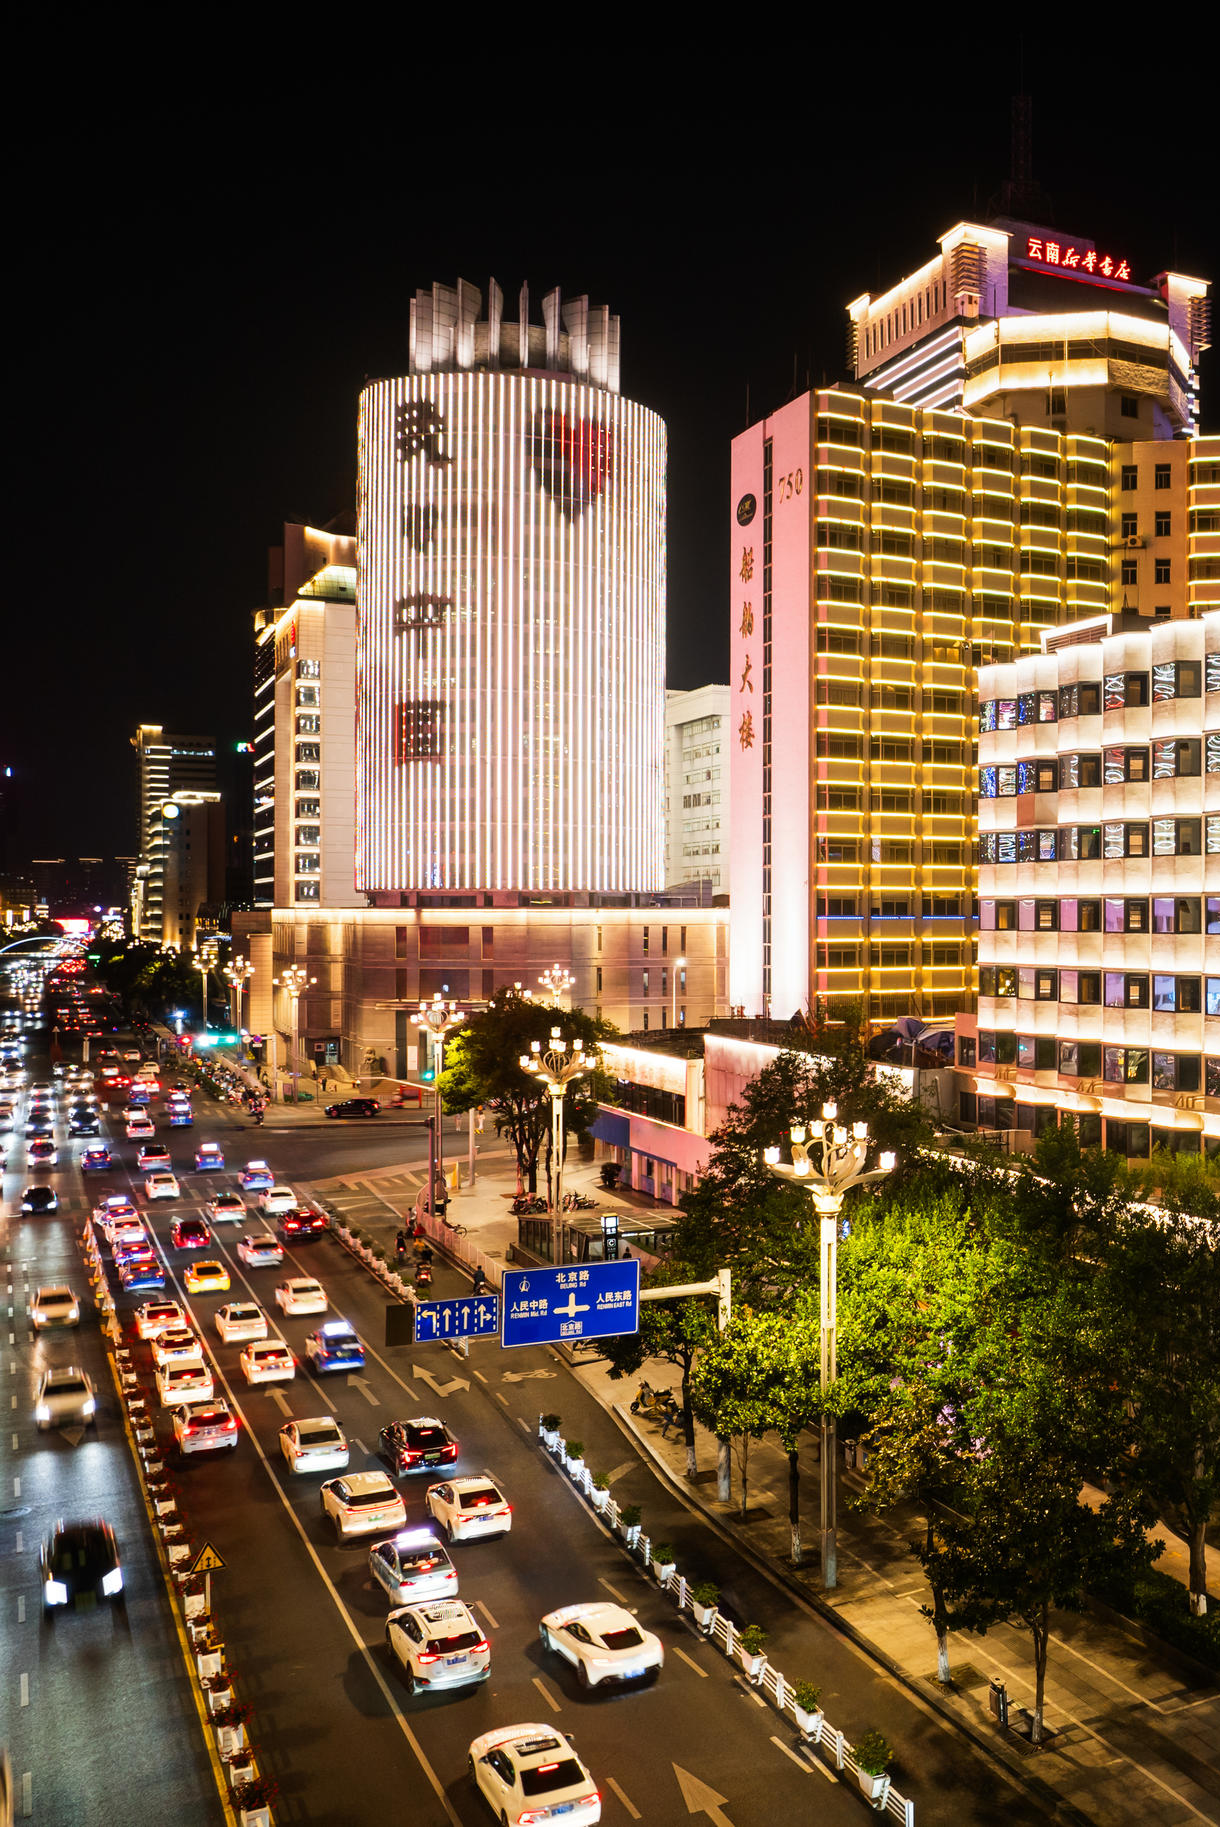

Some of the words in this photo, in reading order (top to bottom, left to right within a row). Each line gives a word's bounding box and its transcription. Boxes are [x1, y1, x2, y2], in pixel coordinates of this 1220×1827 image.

[779, 468, 803, 504] 750
[555, 1270, 590, 1283] 北京路
[596, 1290, 632, 1303] 人民东路
[510, 1299, 548, 1313] 人民中路
